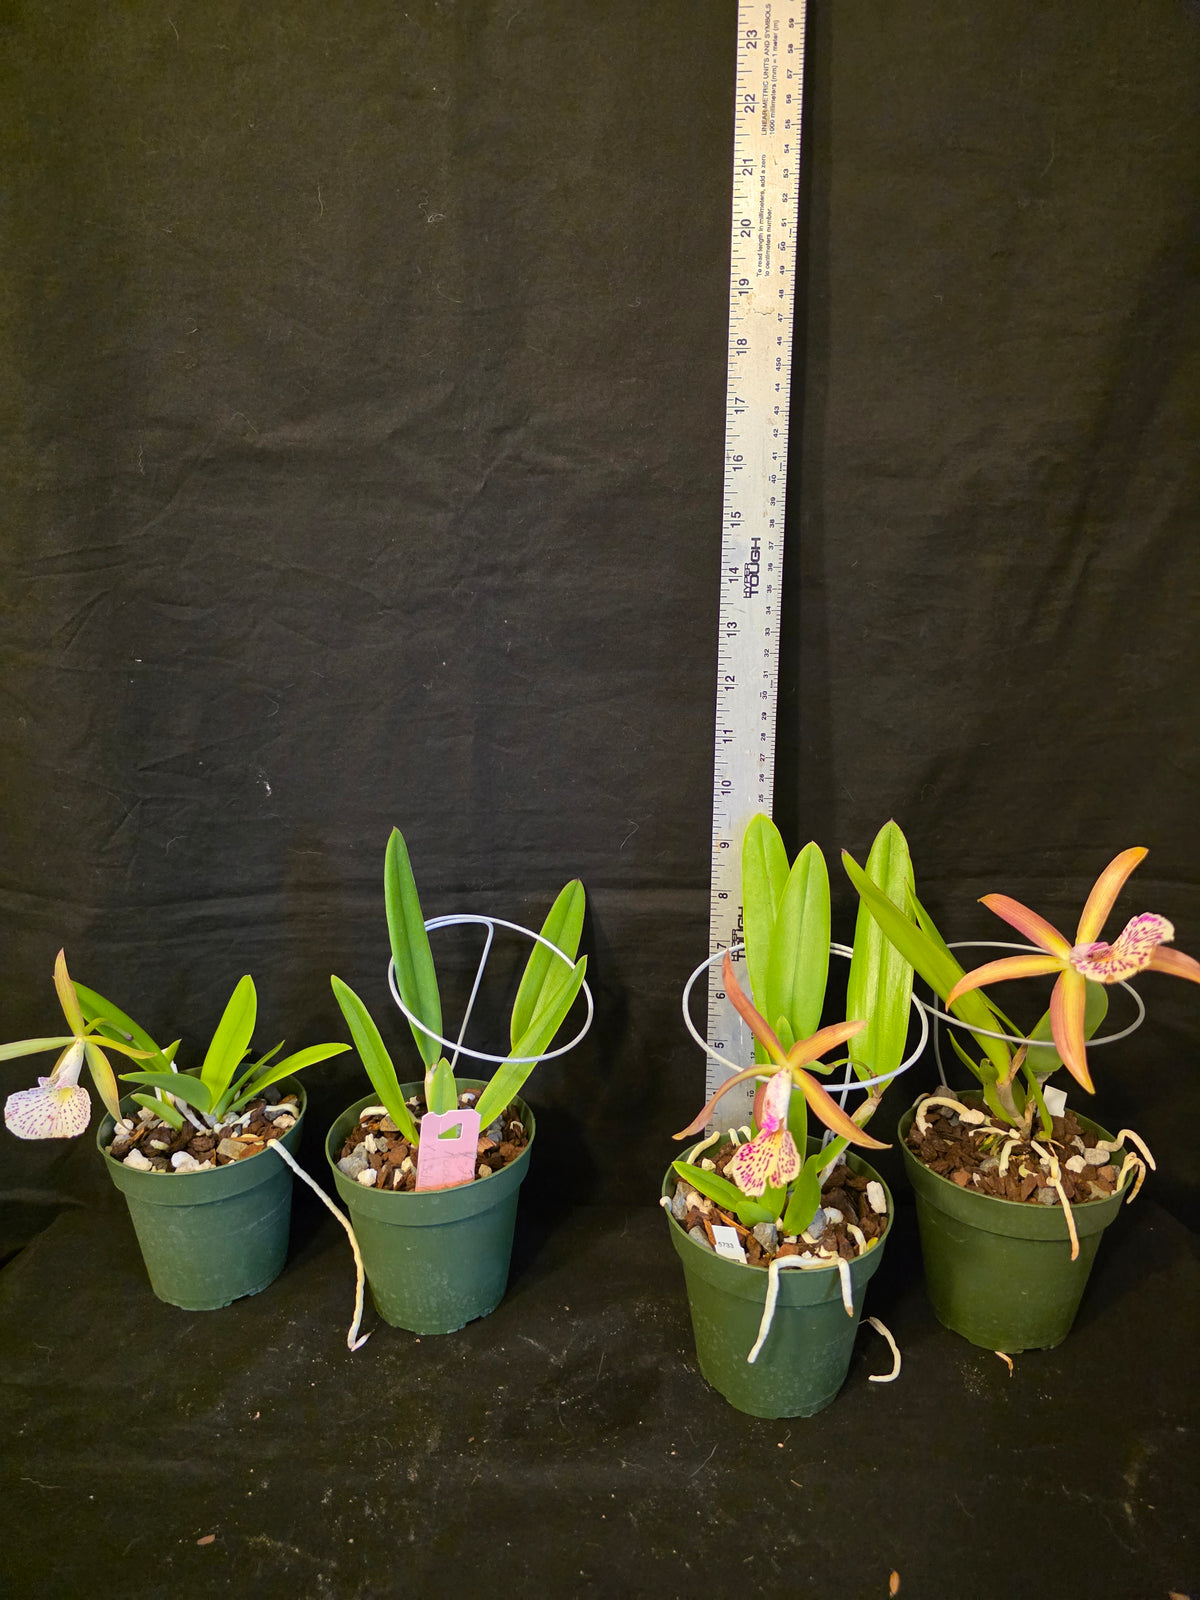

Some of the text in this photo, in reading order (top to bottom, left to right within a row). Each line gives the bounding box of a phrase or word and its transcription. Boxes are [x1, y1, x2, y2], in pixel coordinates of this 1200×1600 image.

[789, 18, 794, 28] 59
[746, 29, 757, 49] 23
[788, 44, 793, 54] 58
[787, 69, 792, 79] 57
[744, 94, 755, 113] 22
[786, 94, 791, 104] 56
[785, 119, 790, 129] 55
[784, 144, 789, 153] 54
[742, 159, 753, 176] 21
[783, 169, 788, 178] 53
[782, 193, 788, 202] 52
[781, 218, 786, 227] 51
[740, 219, 751, 238] 20
[780, 242, 786, 251] 50
[757, 269, 762, 277] To
[780, 266, 785, 275] 49
[738, 279, 749, 296] 19
[779, 289, 784, 299] 48
[778, 313, 783, 322] 47
[736, 338, 747, 356] 18
[775, 383, 780, 392] 44
[734, 397, 745, 414] 17
[774, 406, 780, 415] 43
[773, 429, 778, 437] 42
[772, 452, 777, 460] 41
[732, 455, 743, 471] 16
[772, 475, 776, 484] 40
[770, 497, 776, 506] 39
[730, 511, 741, 528] 15
[770, 519, 775, 528] 38
[768, 541, 774, 550] 37
[750, 537, 761, 594] TOUGH
[728, 567, 739, 583] 14
[743, 563, 752, 598] HYPER
[767, 585, 772, 593] 35
[766, 606, 771, 615] 34
[727, 622, 737, 638] 13
[765, 628, 770, 636] 33
[764, 649, 769, 657] 32
[724, 676, 735, 691] 12
[762, 691, 767, 700] 30
[762, 712, 766, 720] 29
[723, 730, 733, 744] 11
[761, 733, 766, 741] 28
[759, 774, 764, 782] 26
[721, 780, 732, 795] 10
[758, 794, 764, 802] 25
